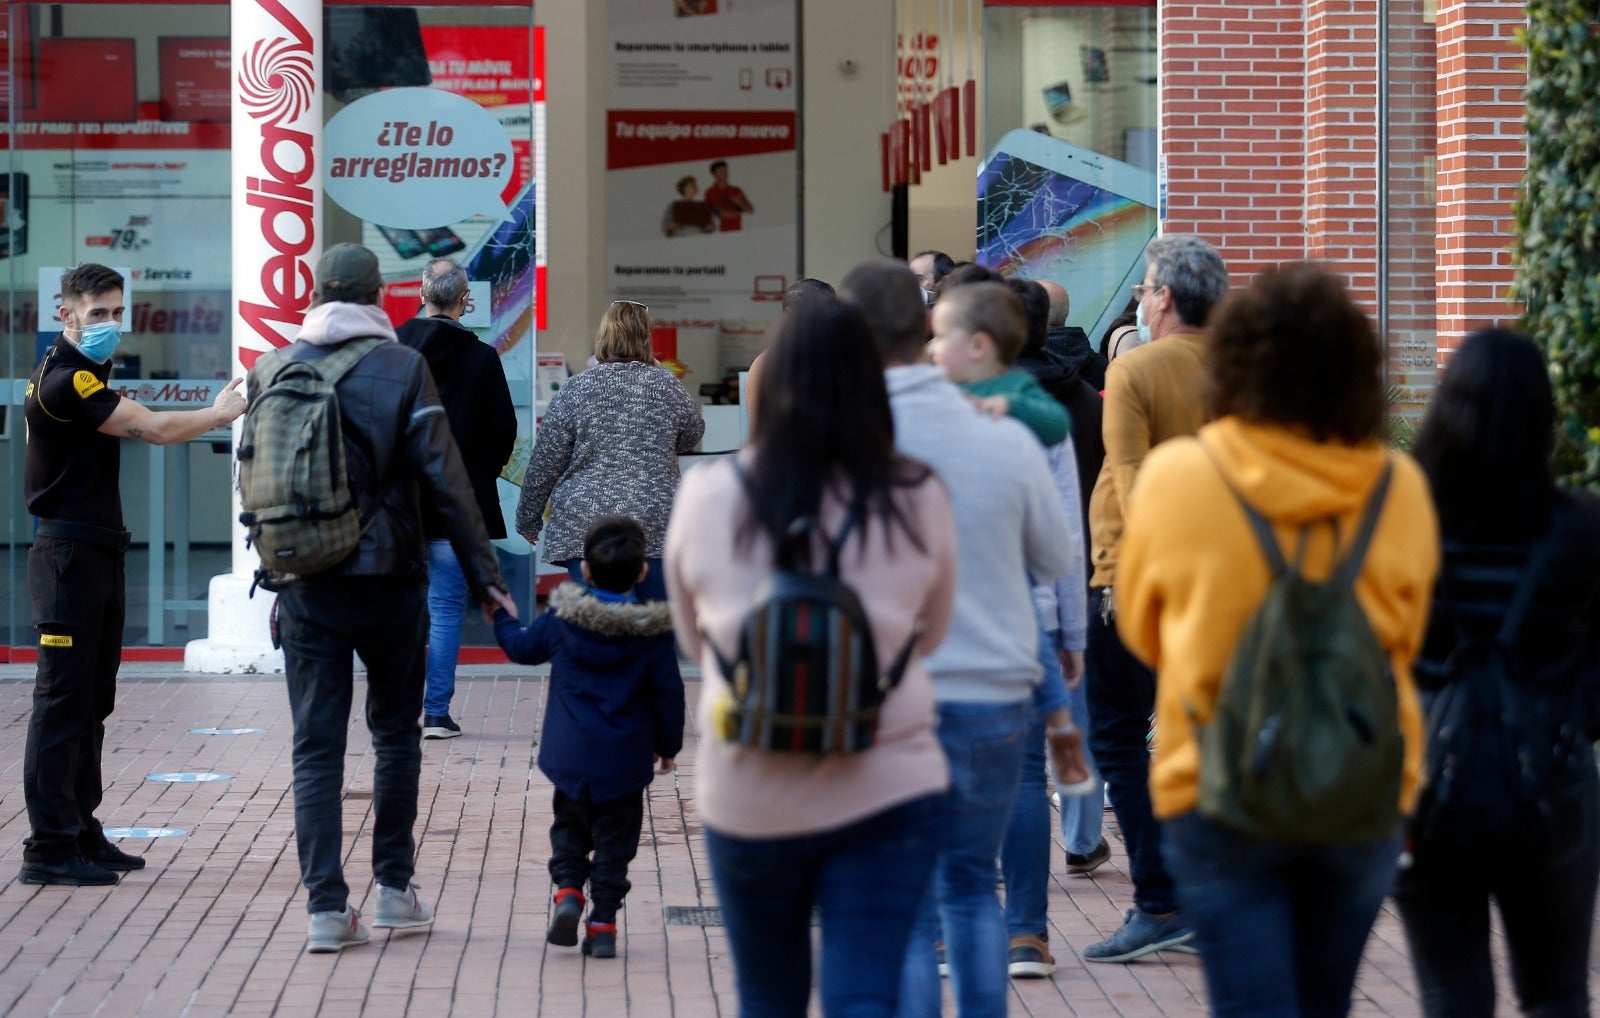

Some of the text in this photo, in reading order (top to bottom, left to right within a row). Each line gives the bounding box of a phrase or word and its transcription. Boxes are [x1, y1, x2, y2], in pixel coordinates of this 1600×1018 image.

[377, 120, 454, 147] ¿Te lo
[615, 121, 790, 142] Tu equipo como nuevo
[330, 151, 507, 183] arreglamos?
[144, 267, 192, 280] Service
